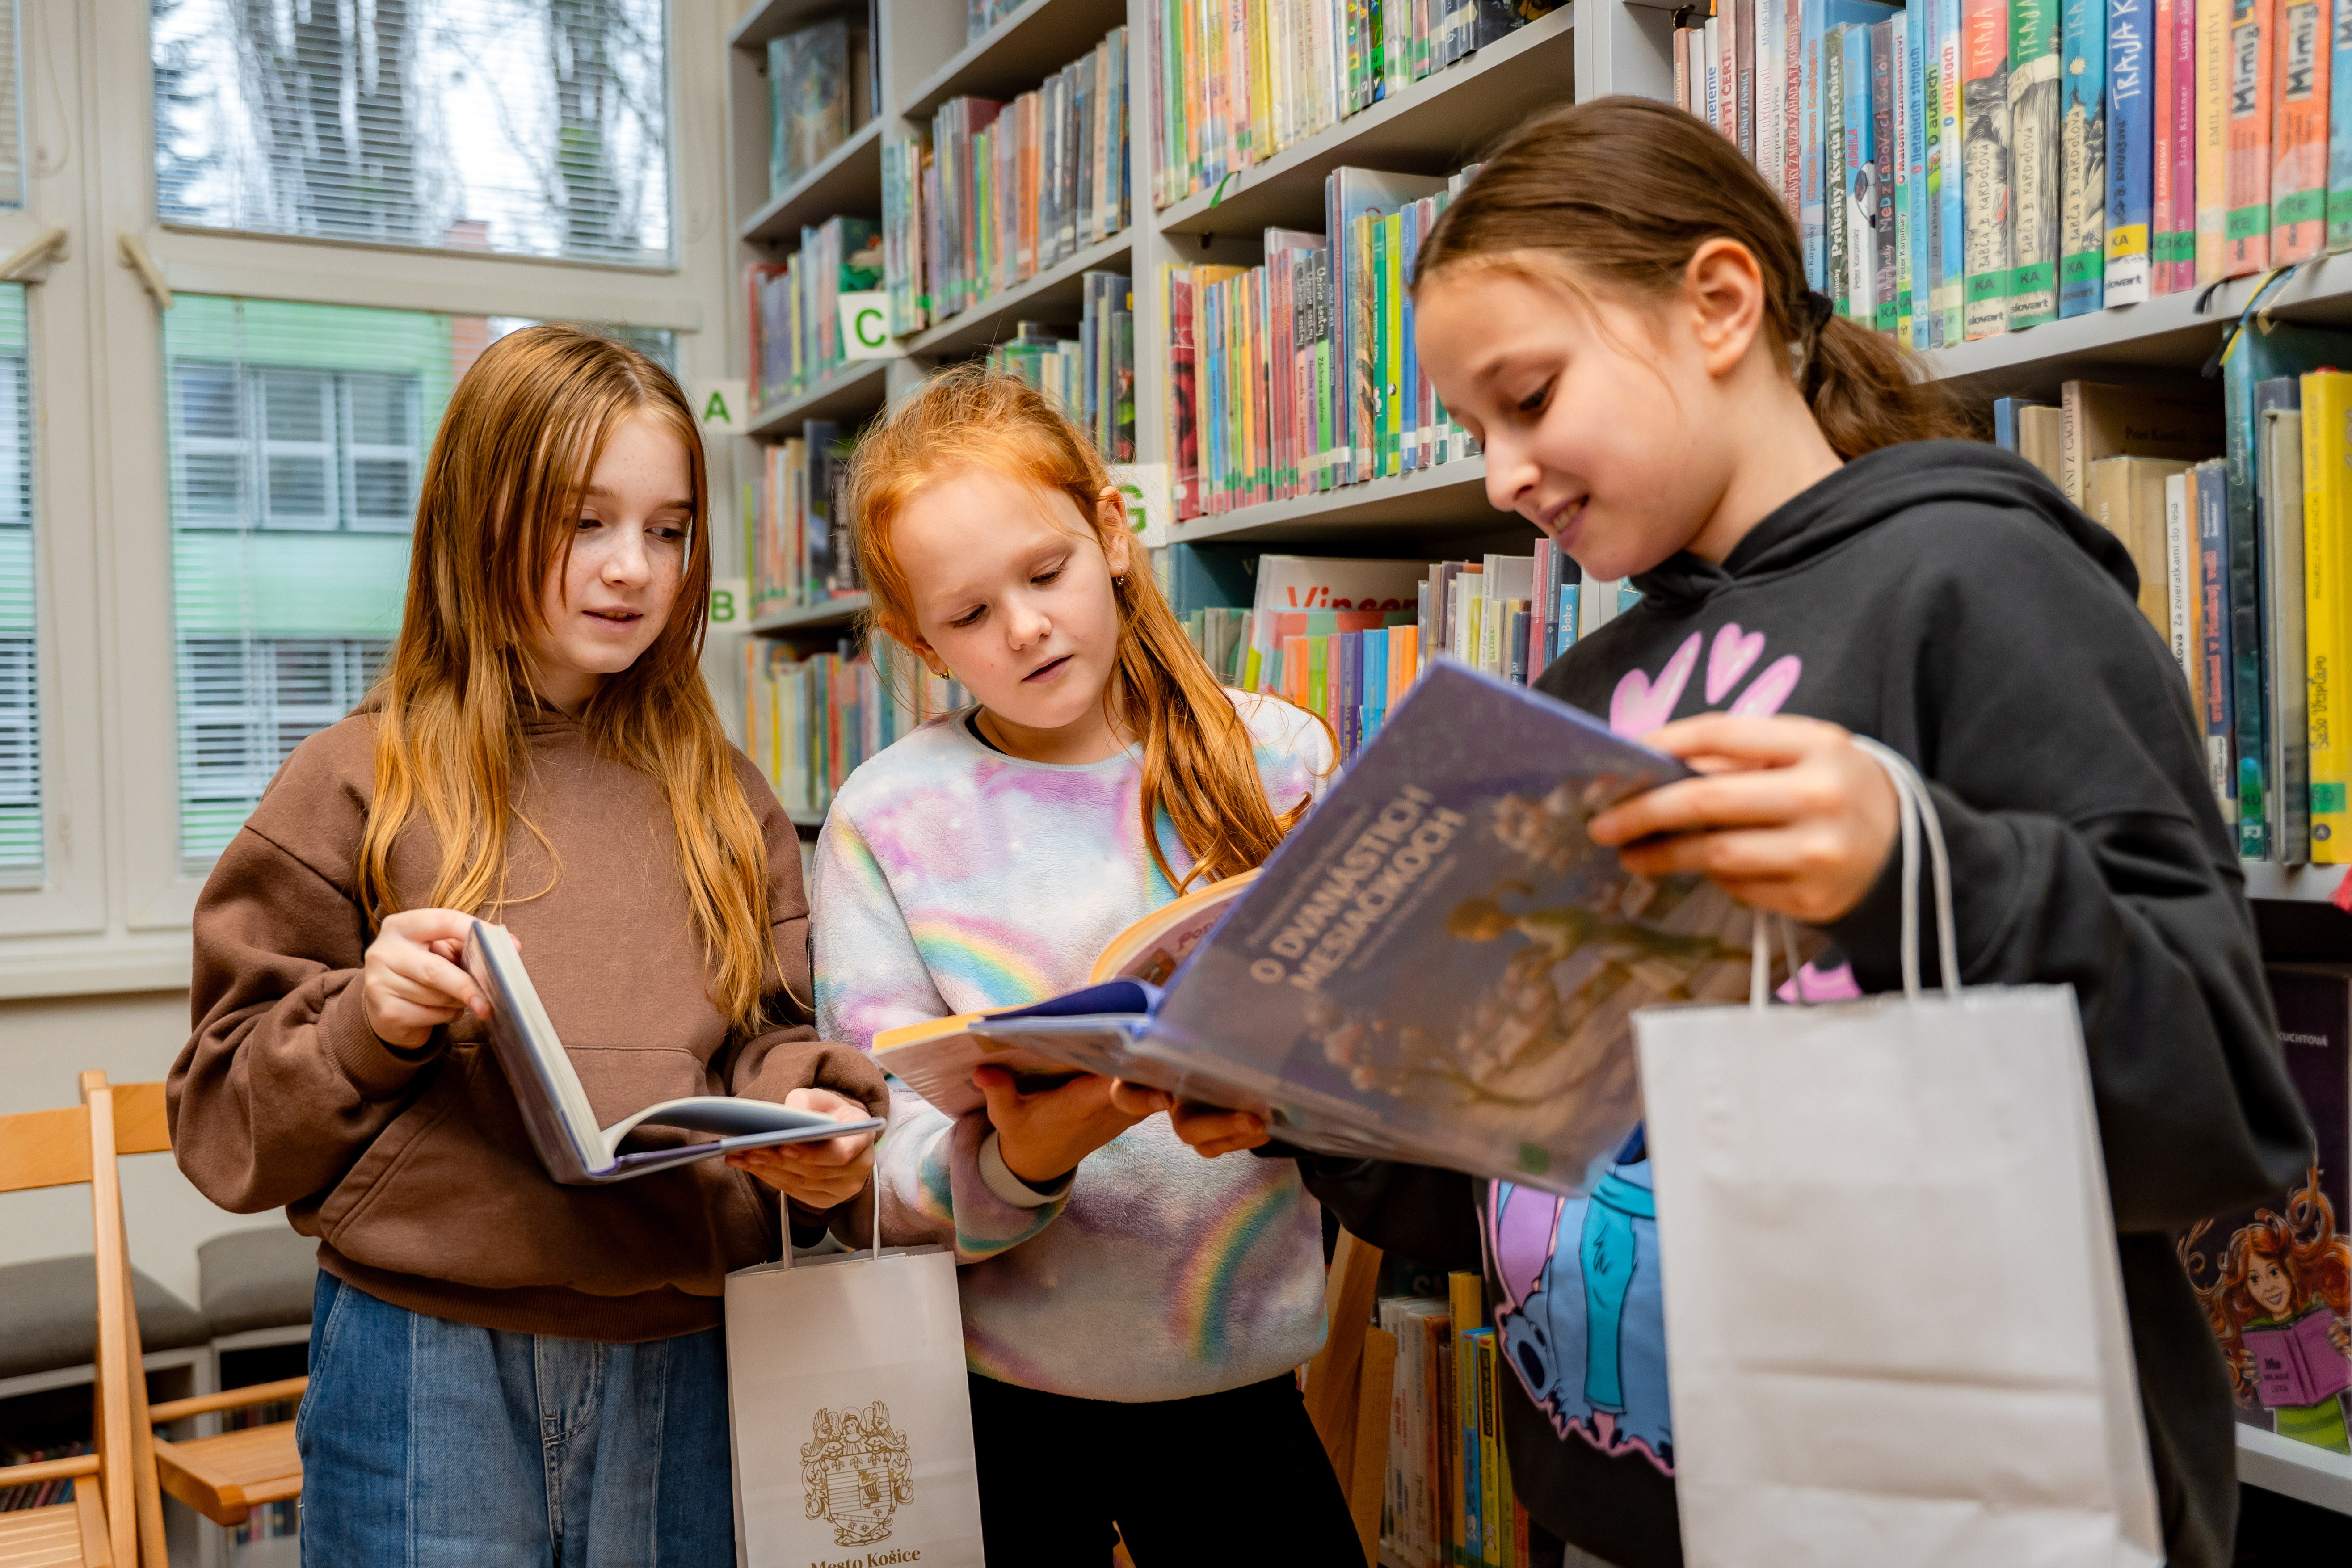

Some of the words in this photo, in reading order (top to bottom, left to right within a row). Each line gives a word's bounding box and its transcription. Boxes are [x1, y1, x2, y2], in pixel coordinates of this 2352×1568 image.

[1971, 6, 1995, 70] TRAJA
[1909, 47, 1922, 94] strojoch
[2108, 21, 2143, 110] TRAJA
[1894, 34, 1904, 127] kozmonautovi
[1942, 46, 1955, 114] vláčikoch
[1925, 68, 1939, 129] autách
[1943, 116, 1954, 127] O
[1896, 128, 1905, 172] Malom
[1927, 134, 1939, 146] O
[1897, 174, 1905, 185] O
[1898, 213, 1907, 256] Karpinský
[2111, 234, 2129, 247] KA
[2020, 271, 2040, 284] KA
[2066, 260, 2085, 274] KA
[1975, 279, 1994, 292] KA
[2105, 273, 2142, 290] slovart
[2010, 298, 2049, 313] slovart
[855, 309, 887, 347] C
[1315, 305, 1327, 336] sestry
[1967, 311, 2004, 326] slovart
[703, 392, 732, 424] A
[2168, 503, 2179, 524] lesa
[2170, 527, 2179, 542] do
[2171, 545, 2183, 610] zvieratkami
[711, 591, 735, 622] B
[1561, 604, 1573, 632] Bobo
[2173, 614, 2183, 627] Za
[866, 1549, 921, 1568] Košice
